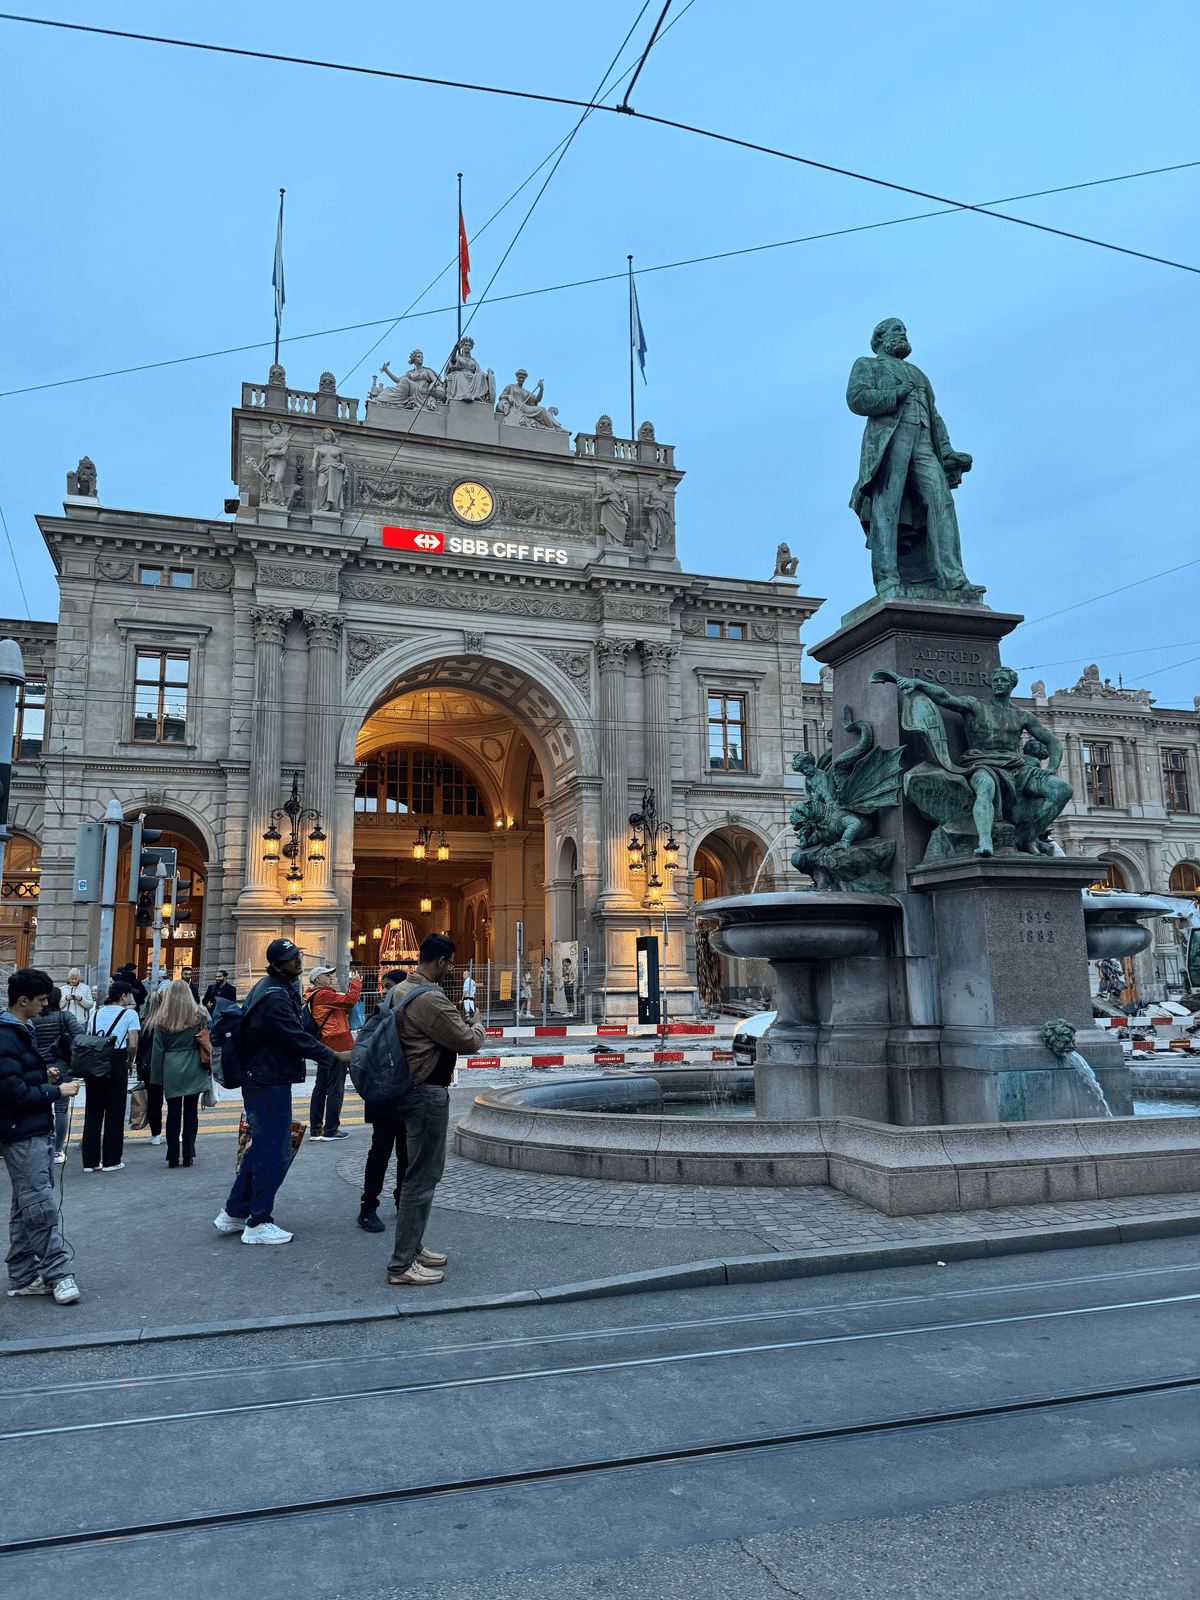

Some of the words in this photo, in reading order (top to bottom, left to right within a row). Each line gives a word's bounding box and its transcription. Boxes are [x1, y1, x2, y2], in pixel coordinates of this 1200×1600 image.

[449, 537, 489, 556] SBB
[493, 542, 529, 560] CFF
[533, 547, 568, 565] FFS
[915, 649, 982, 664] ALFRED
[1018, 910, 1051, 923] 1819
[1018, 930, 1055, 943] 1882
